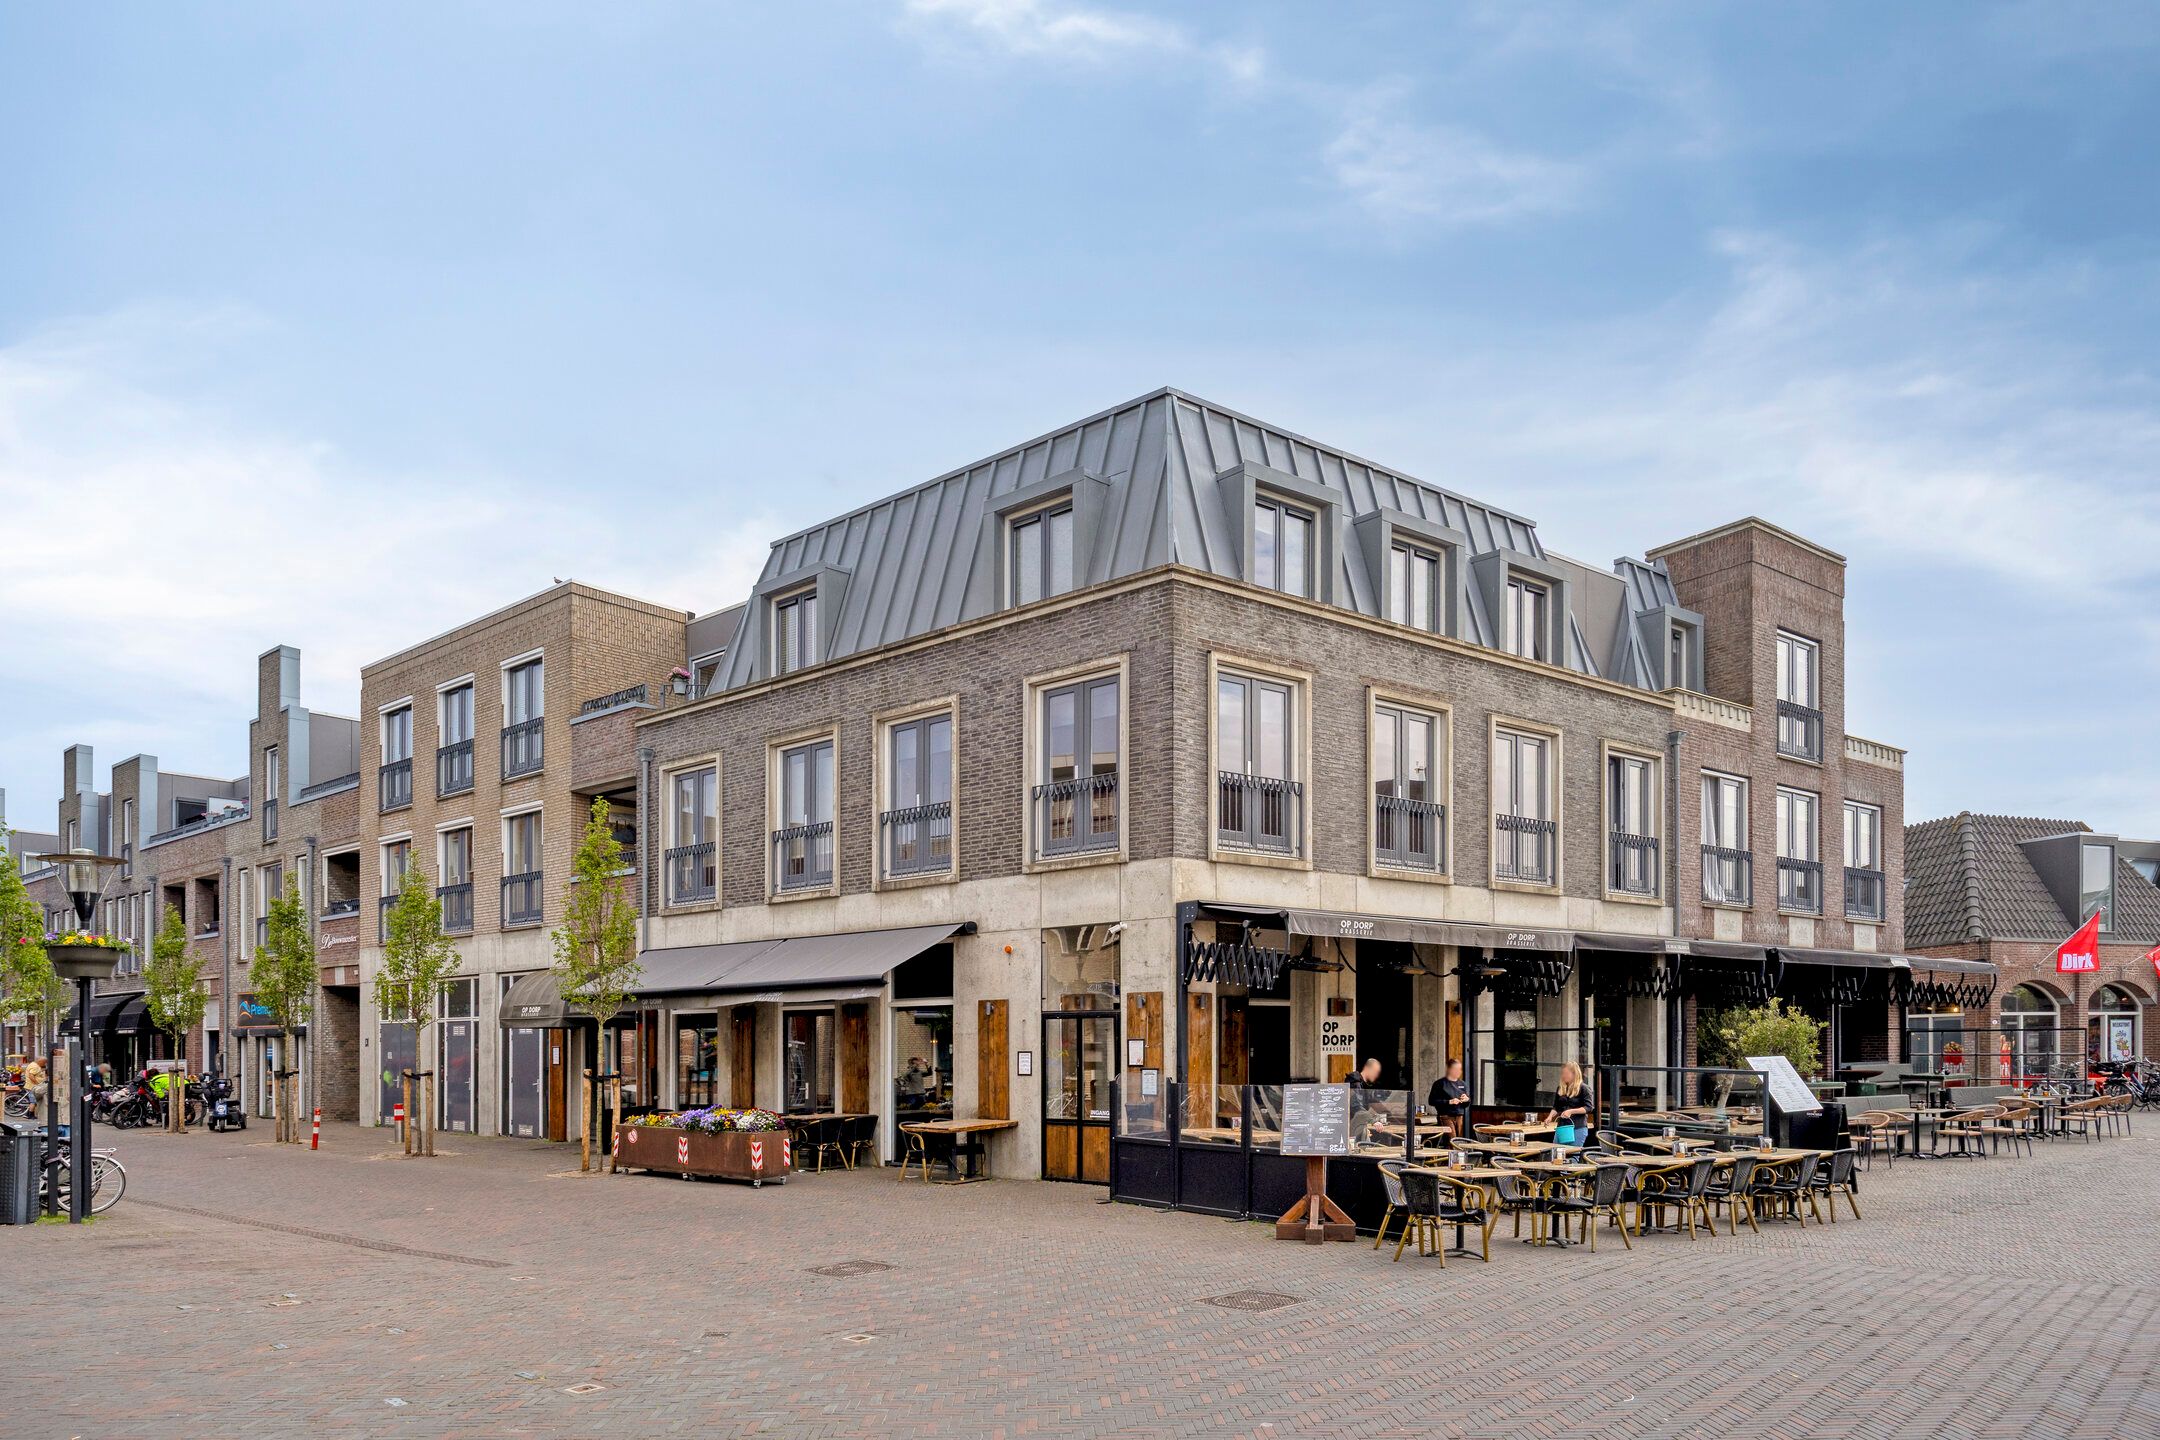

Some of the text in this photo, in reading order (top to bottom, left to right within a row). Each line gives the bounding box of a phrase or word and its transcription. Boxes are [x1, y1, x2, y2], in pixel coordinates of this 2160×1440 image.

[2061, 953, 2094, 968] Dirk
[1323, 1022, 1338, 1032] OP
[1323, 1035, 1354, 1045] DORP
